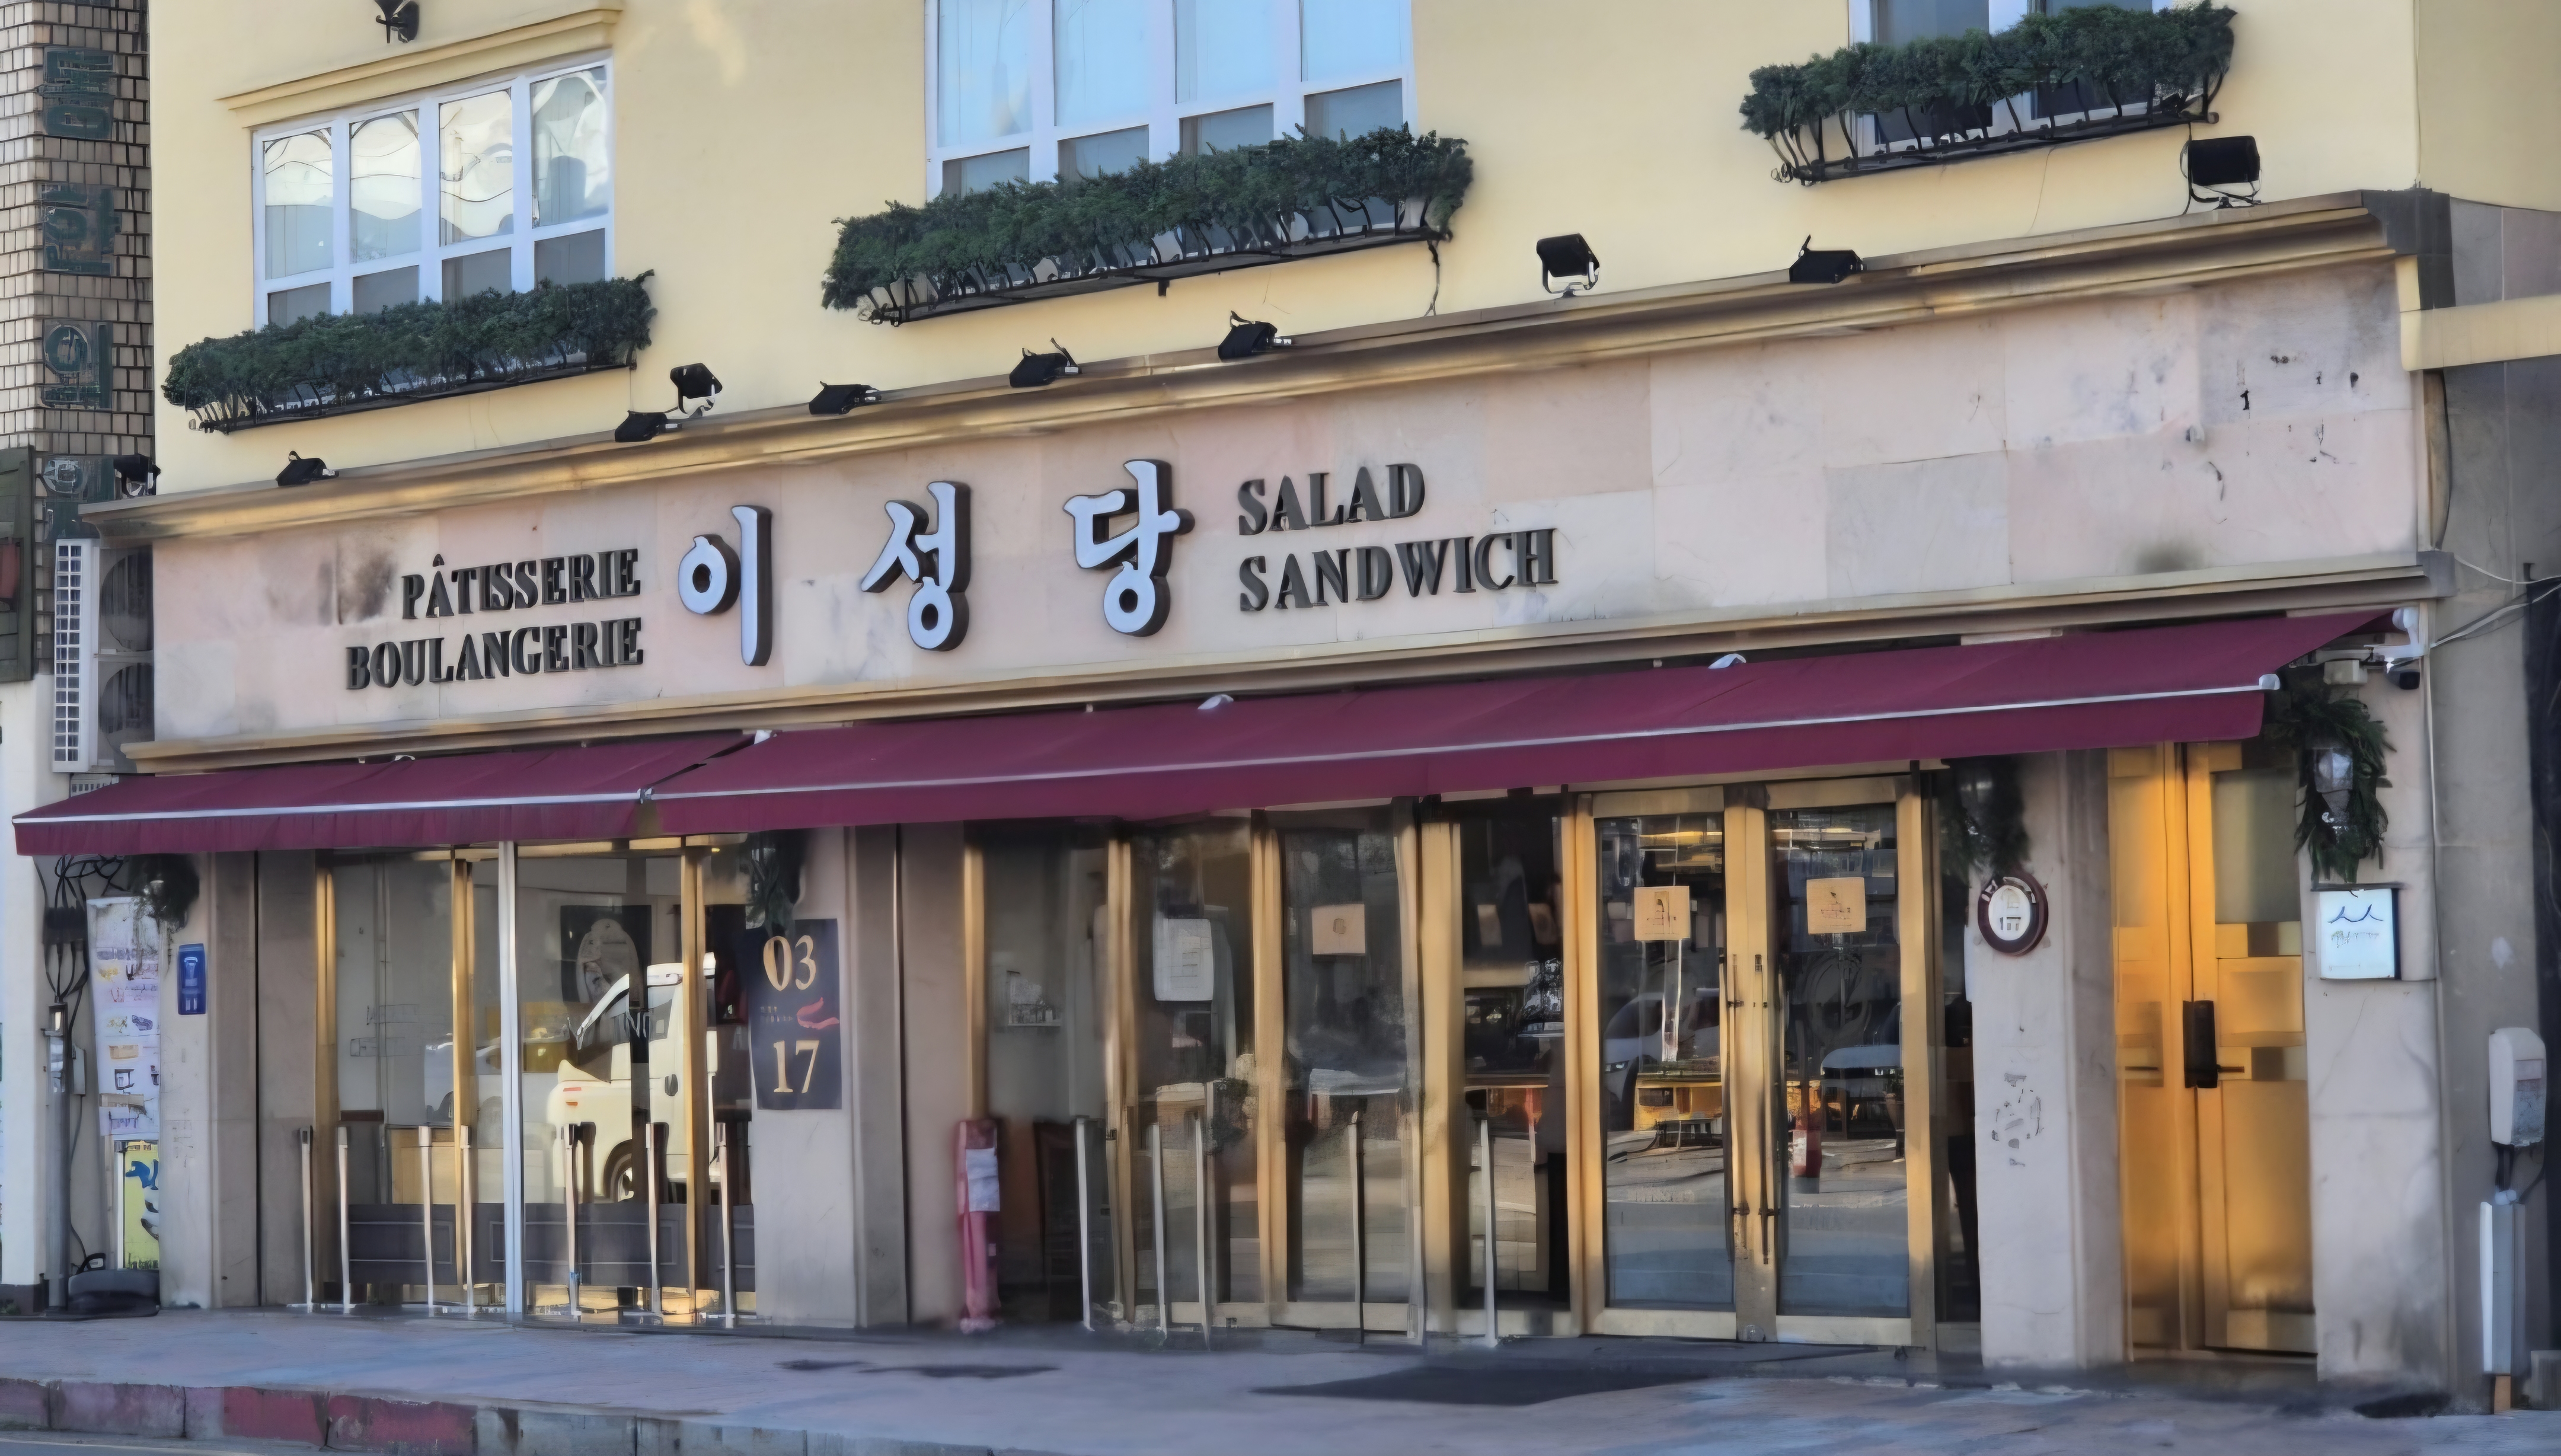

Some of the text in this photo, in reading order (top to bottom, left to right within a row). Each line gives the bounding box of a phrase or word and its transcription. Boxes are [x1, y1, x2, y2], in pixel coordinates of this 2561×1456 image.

[1238, 462, 1425, 537] SALAD
[401, 548, 641, 620] PÂTISSERIE
[1239, 527, 1560, 612] SANDWICH
[346, 617, 644, 690] BOULANGERIE
[763, 935, 816, 991] 03
[773, 1040, 820, 1094] 17
